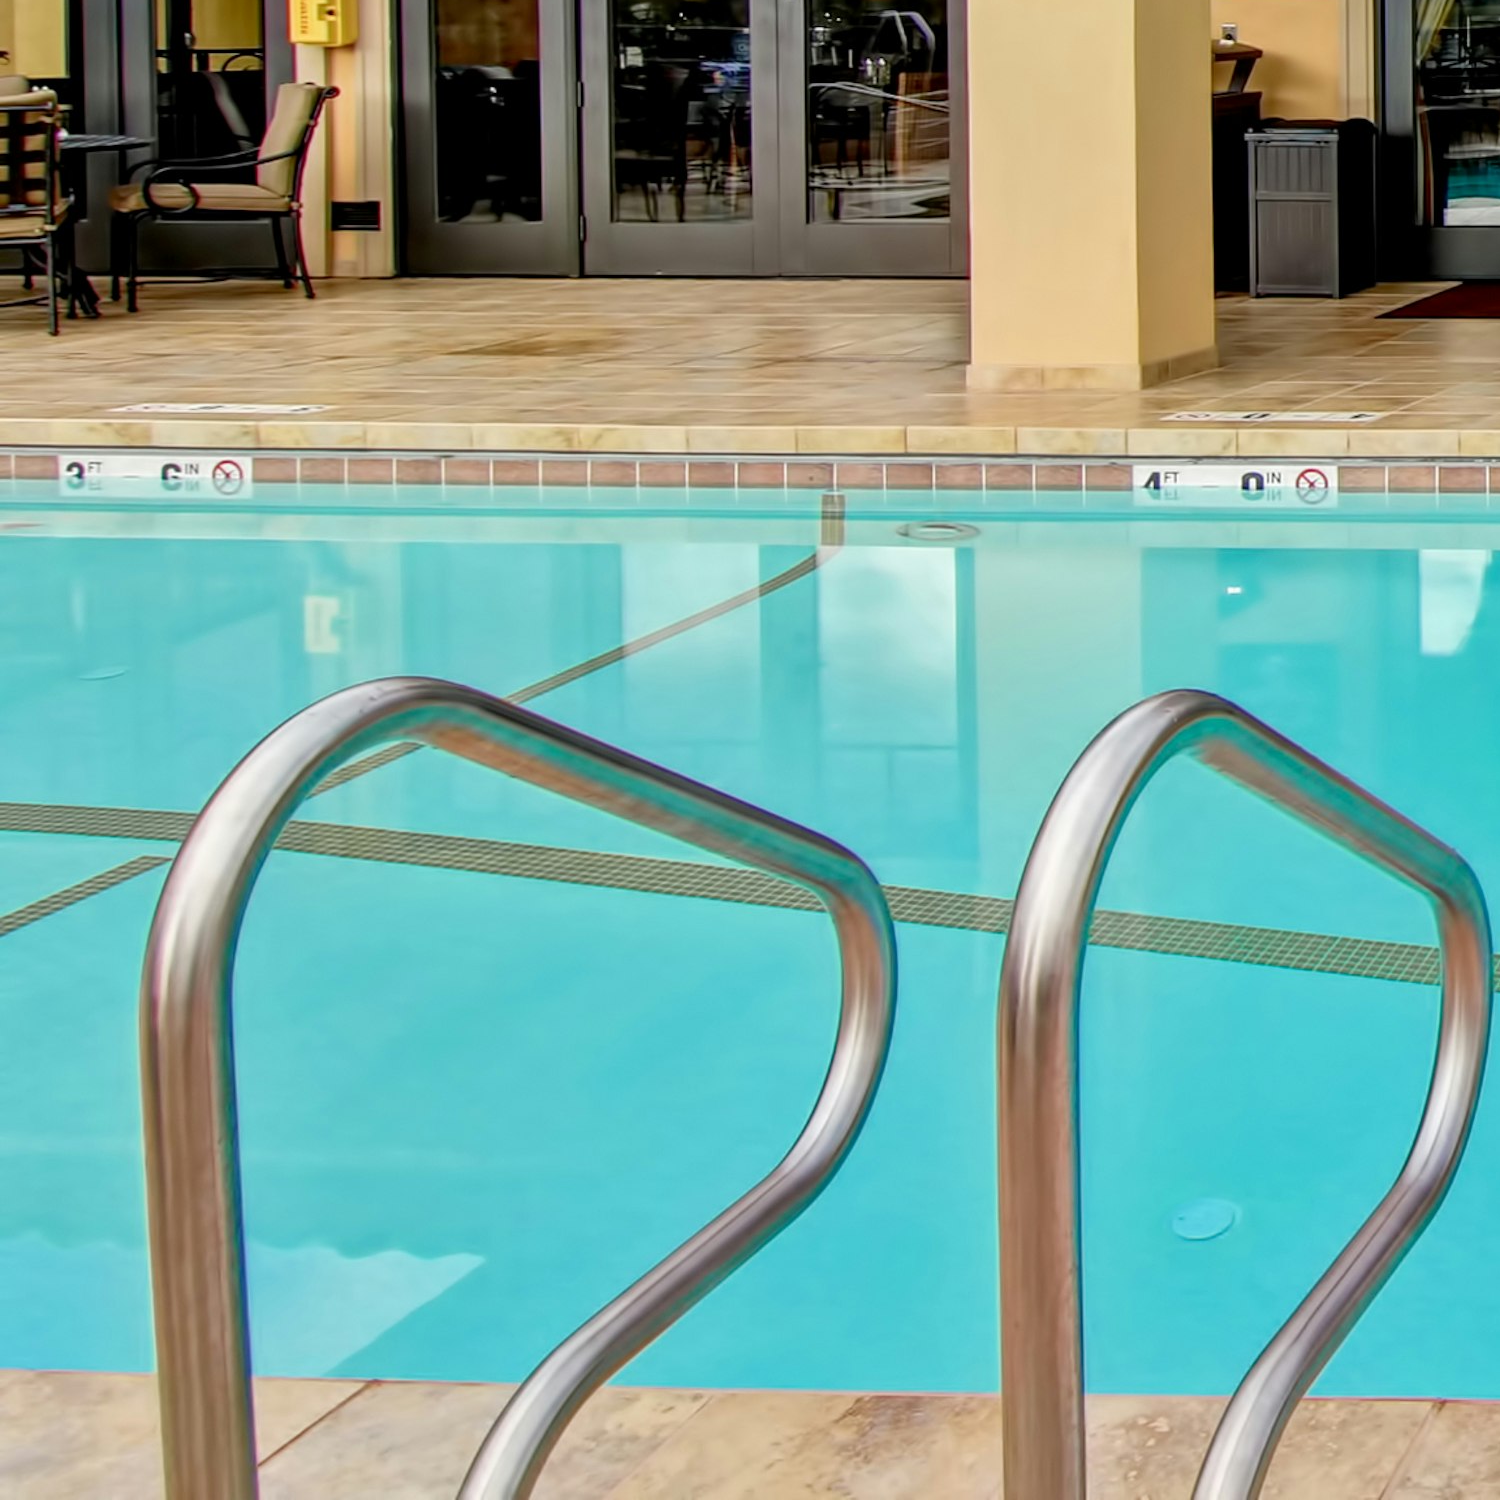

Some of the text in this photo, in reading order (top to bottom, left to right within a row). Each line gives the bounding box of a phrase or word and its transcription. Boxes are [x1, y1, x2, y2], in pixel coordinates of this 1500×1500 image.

[88, 462, 102, 474] FT
[185, 463, 199, 475] IN
[1164, 472, 1179, 484] FT
[1267, 472, 1281, 485] IN
